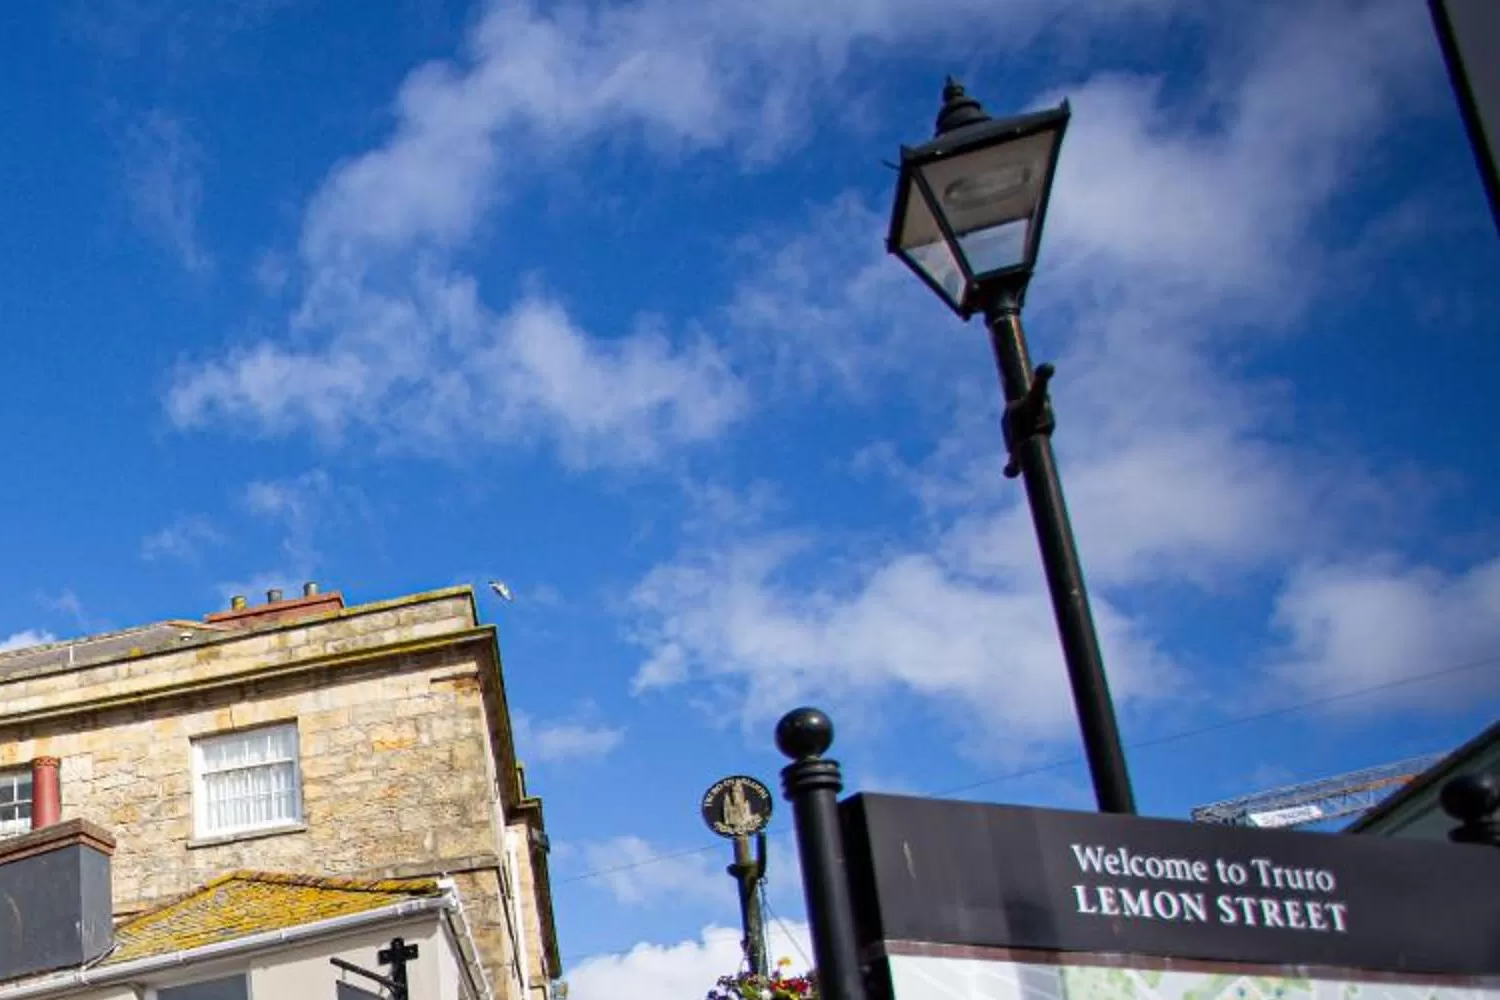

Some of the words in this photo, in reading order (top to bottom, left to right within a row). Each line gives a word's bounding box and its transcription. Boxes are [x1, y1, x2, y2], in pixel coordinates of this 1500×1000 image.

[1071, 843, 1208, 882] Welcome
[1215, 857, 1248, 886] to
[1252, 858, 1335, 893] Truro
[1073, 884, 1208, 923] LEMON
[1216, 894, 1349, 933] STREET
